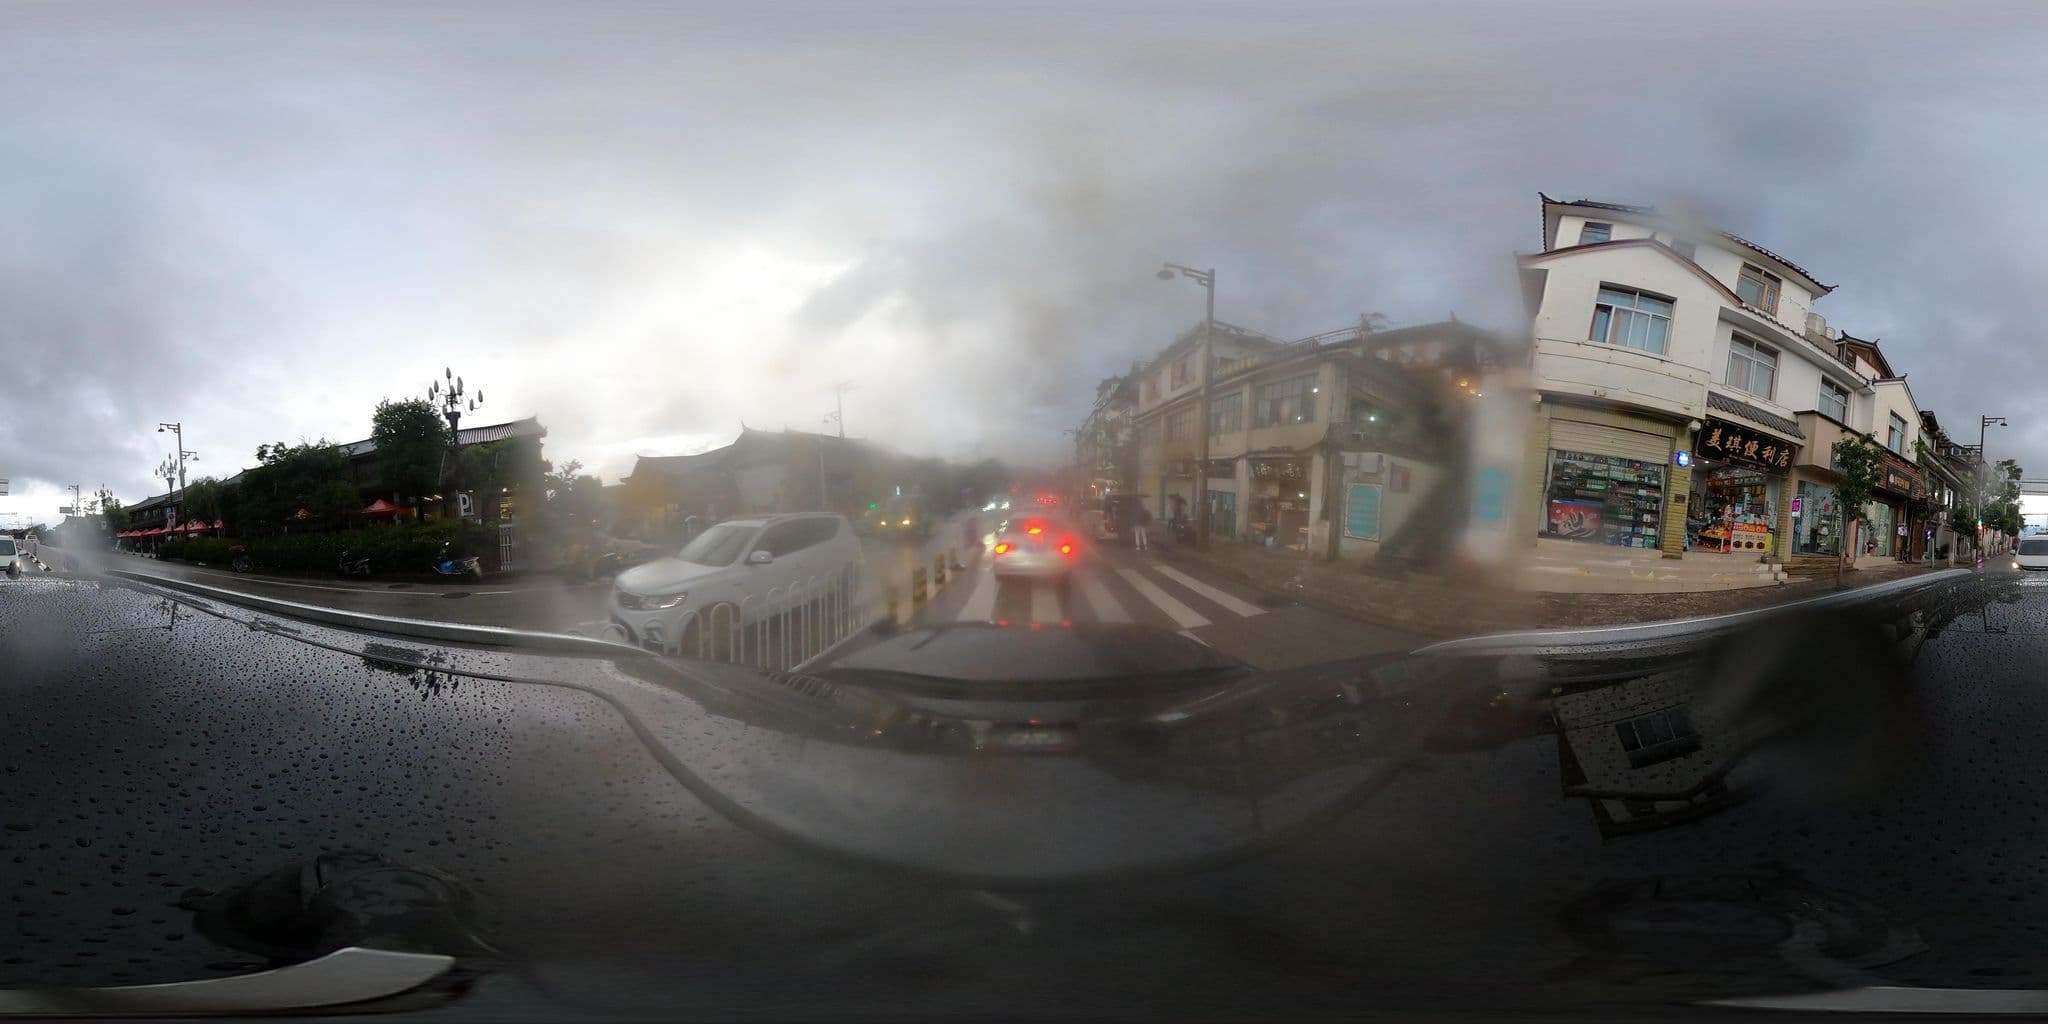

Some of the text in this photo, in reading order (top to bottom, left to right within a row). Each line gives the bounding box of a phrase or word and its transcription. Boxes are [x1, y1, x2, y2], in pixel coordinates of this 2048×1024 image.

[1705, 428, 1790, 467] 美琪便利店
